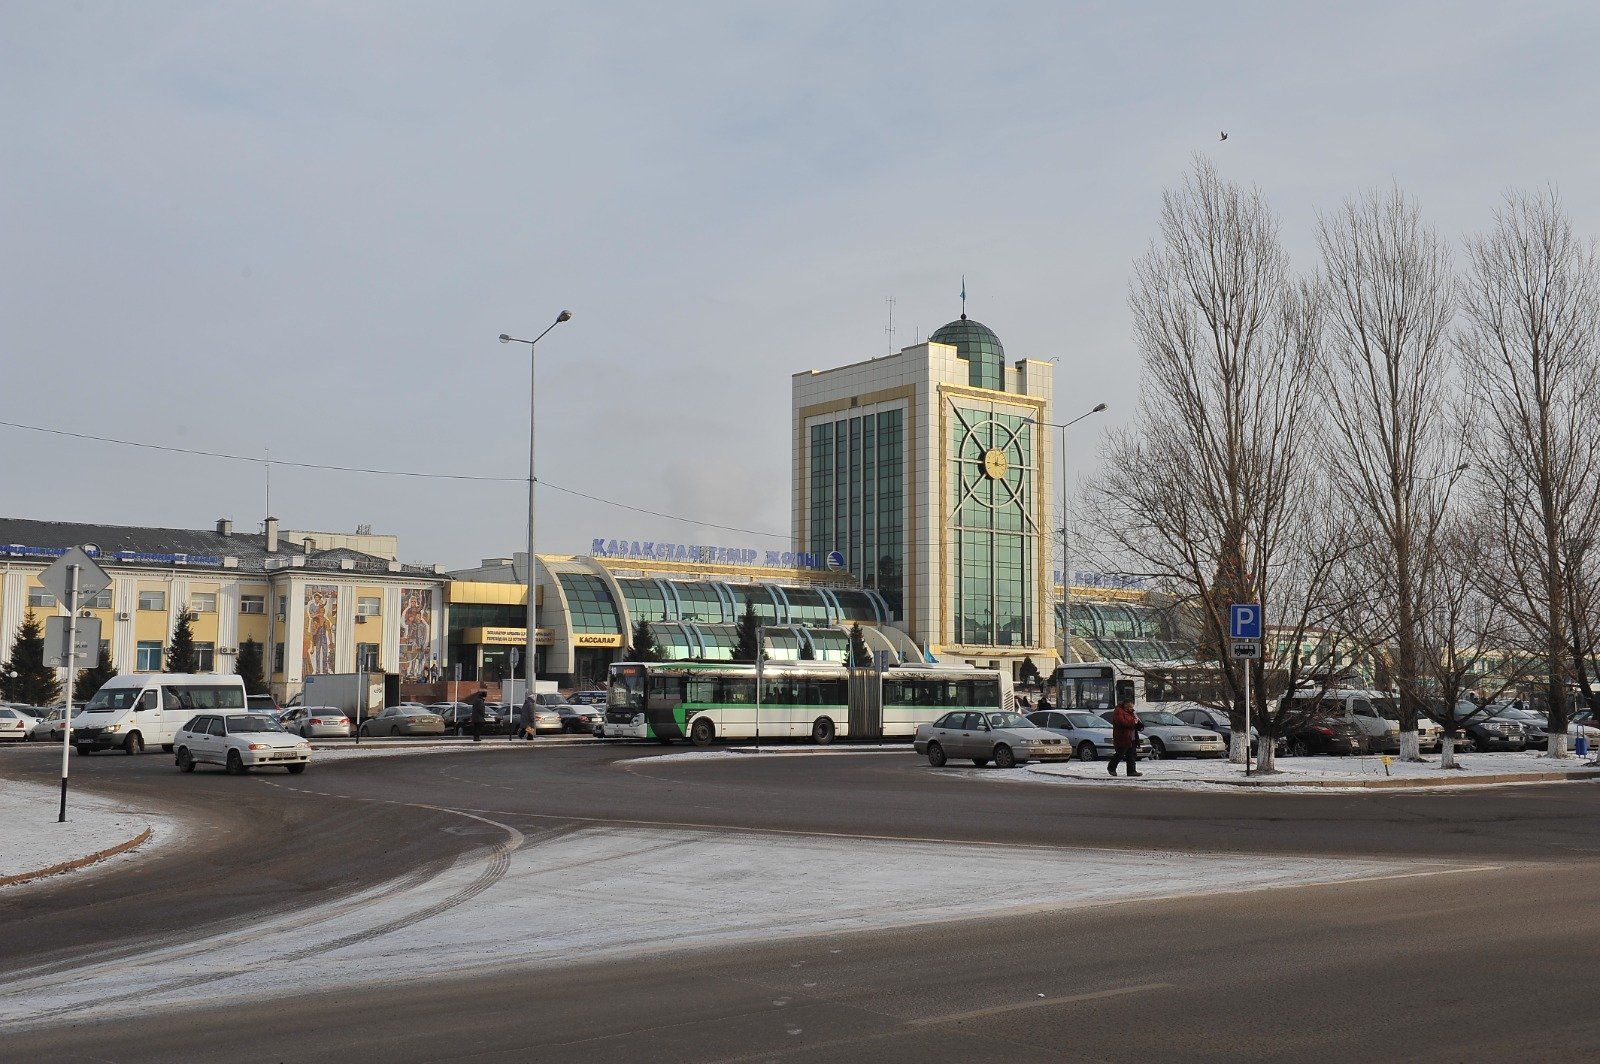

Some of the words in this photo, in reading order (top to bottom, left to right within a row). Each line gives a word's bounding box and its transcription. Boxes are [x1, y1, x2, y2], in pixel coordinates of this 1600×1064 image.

[709, 546, 758, 564] ТЕМІР
[766, 550, 819, 567] ЖОЛЫ
[1237, 608, 1254, 635] P
[579, 636, 616, 644] КАССАЛАР
